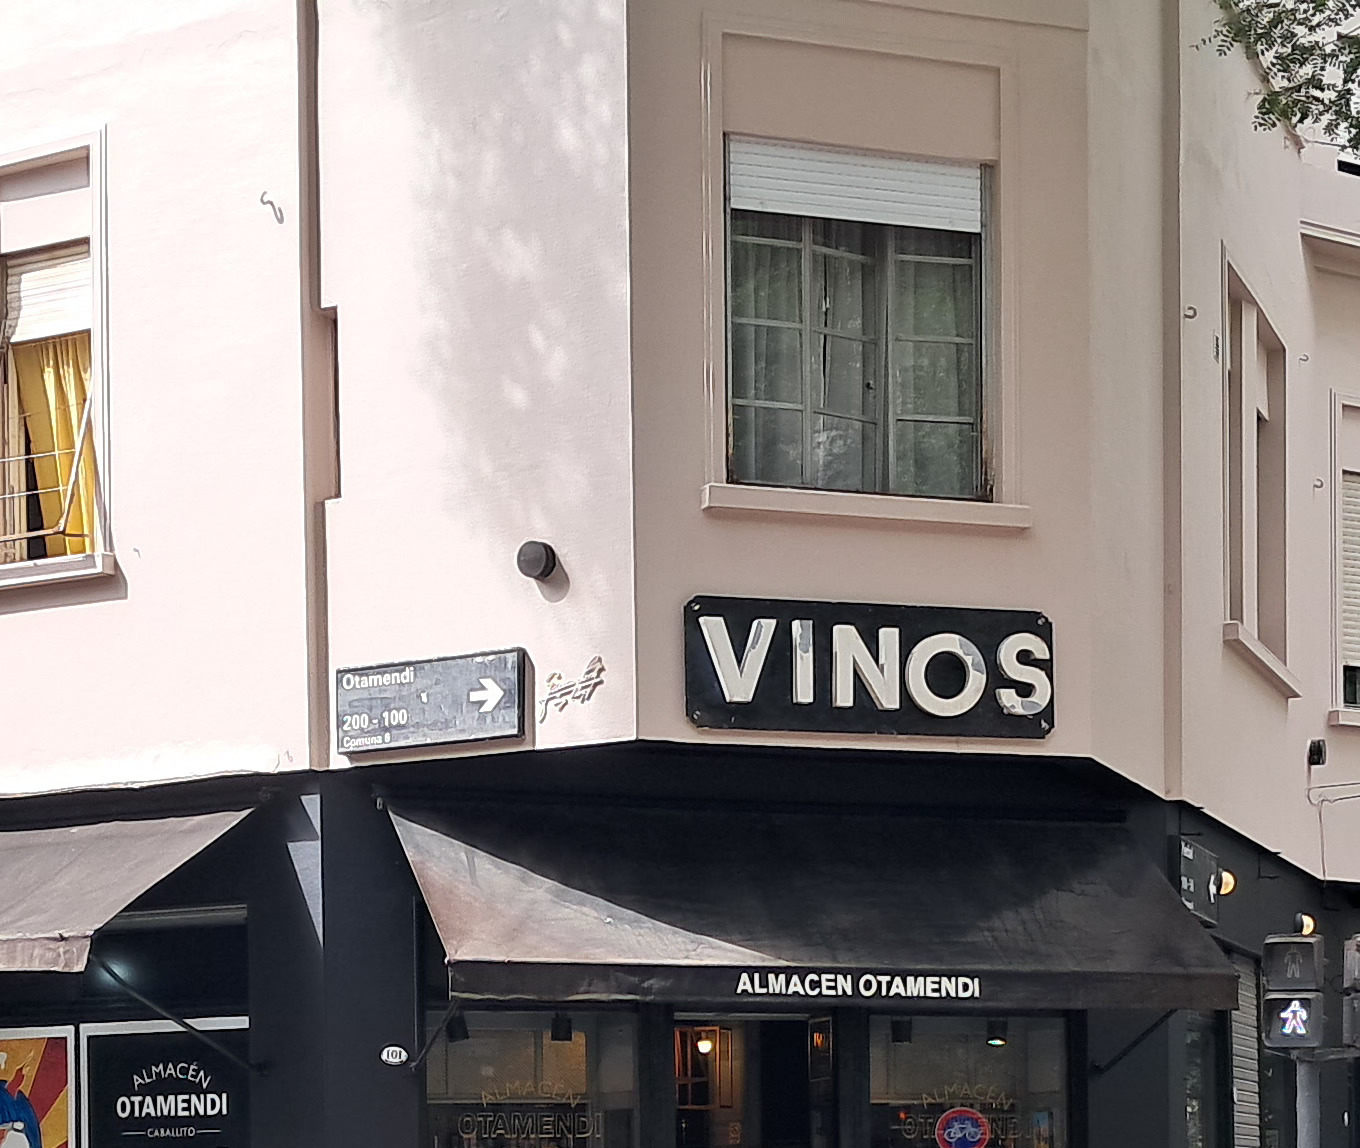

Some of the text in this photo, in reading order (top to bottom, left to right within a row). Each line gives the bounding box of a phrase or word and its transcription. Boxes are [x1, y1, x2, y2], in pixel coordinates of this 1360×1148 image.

[342, 666, 415, 690] Otamendi
[697, 615, 1052, 717] VINOS
[342, 713, 369, 731] 200
[382, 709, 408, 727] 100
[343, 735, 383, 748] Comuna
[736, 972, 981, 998] ALMACEN OTAMENDI
[386, 1049, 403, 1060] 101
[132, 1061, 212, 1091] ALMACÉN
[116, 1092, 228, 1118] OTAMENDI
[146, 1126, 196, 1138] CABALLITO
[457, 1112, 602, 1138] OTAMENDI
